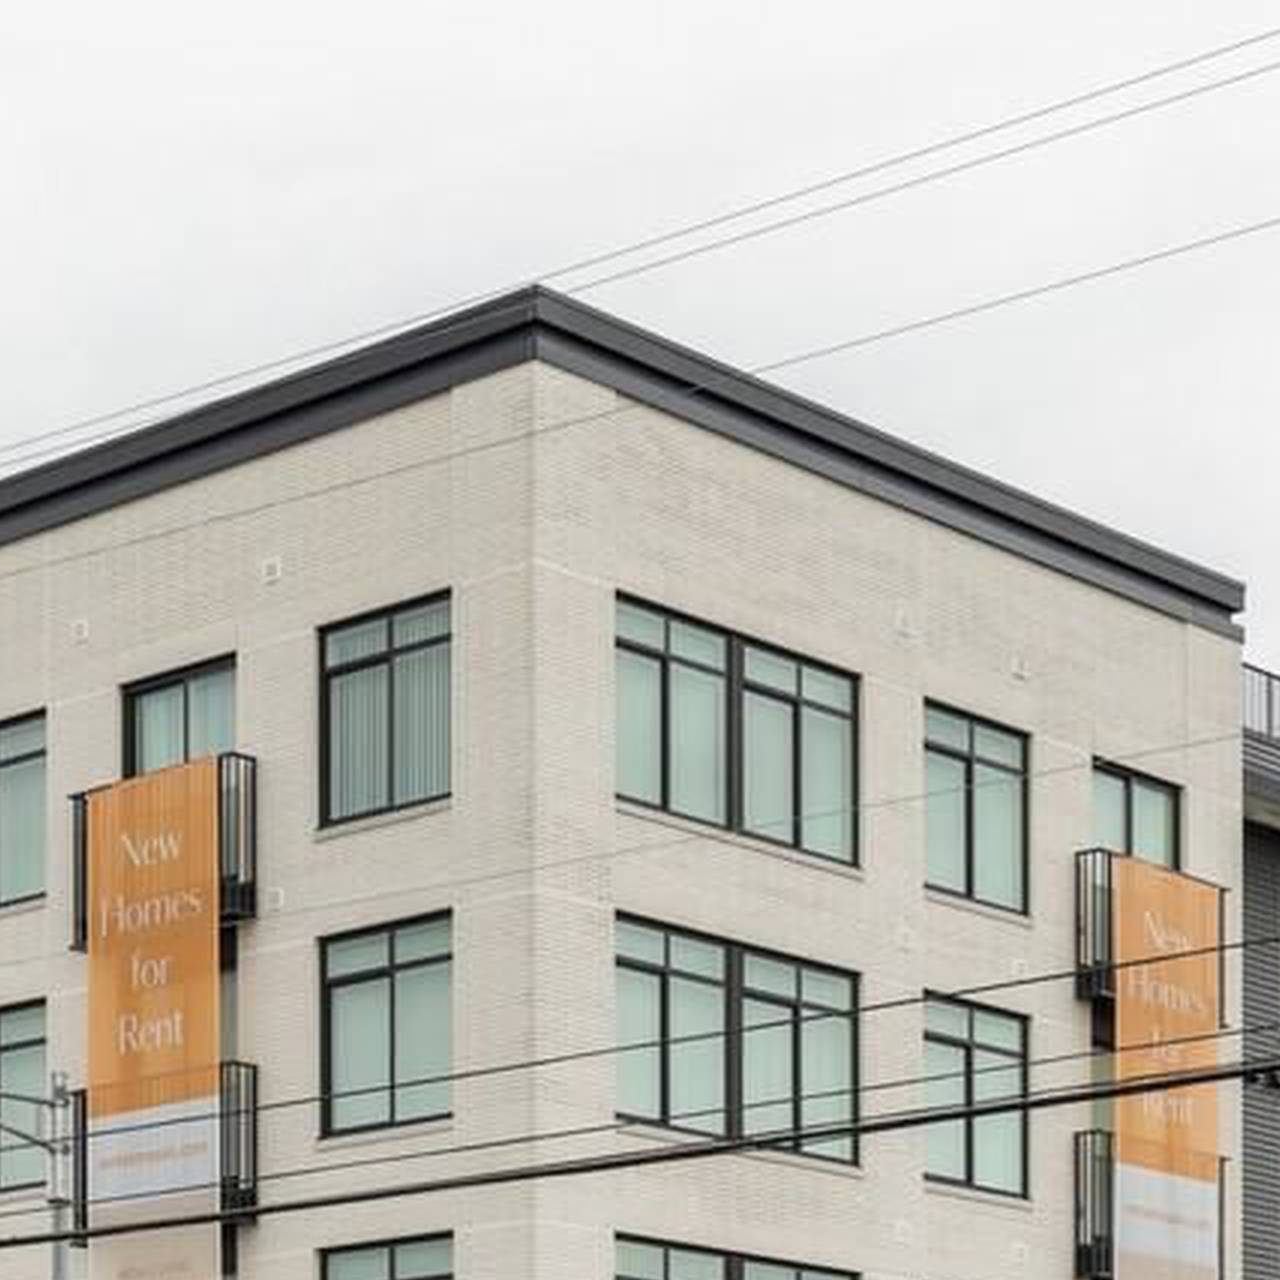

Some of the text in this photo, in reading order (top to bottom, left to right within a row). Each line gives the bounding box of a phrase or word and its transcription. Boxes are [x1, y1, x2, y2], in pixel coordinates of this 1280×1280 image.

[120, 829, 183, 866] New
[99, 886, 202, 938] Homes
[129, 952, 171, 990] for
[116, 1008, 184, 1057] Rent
